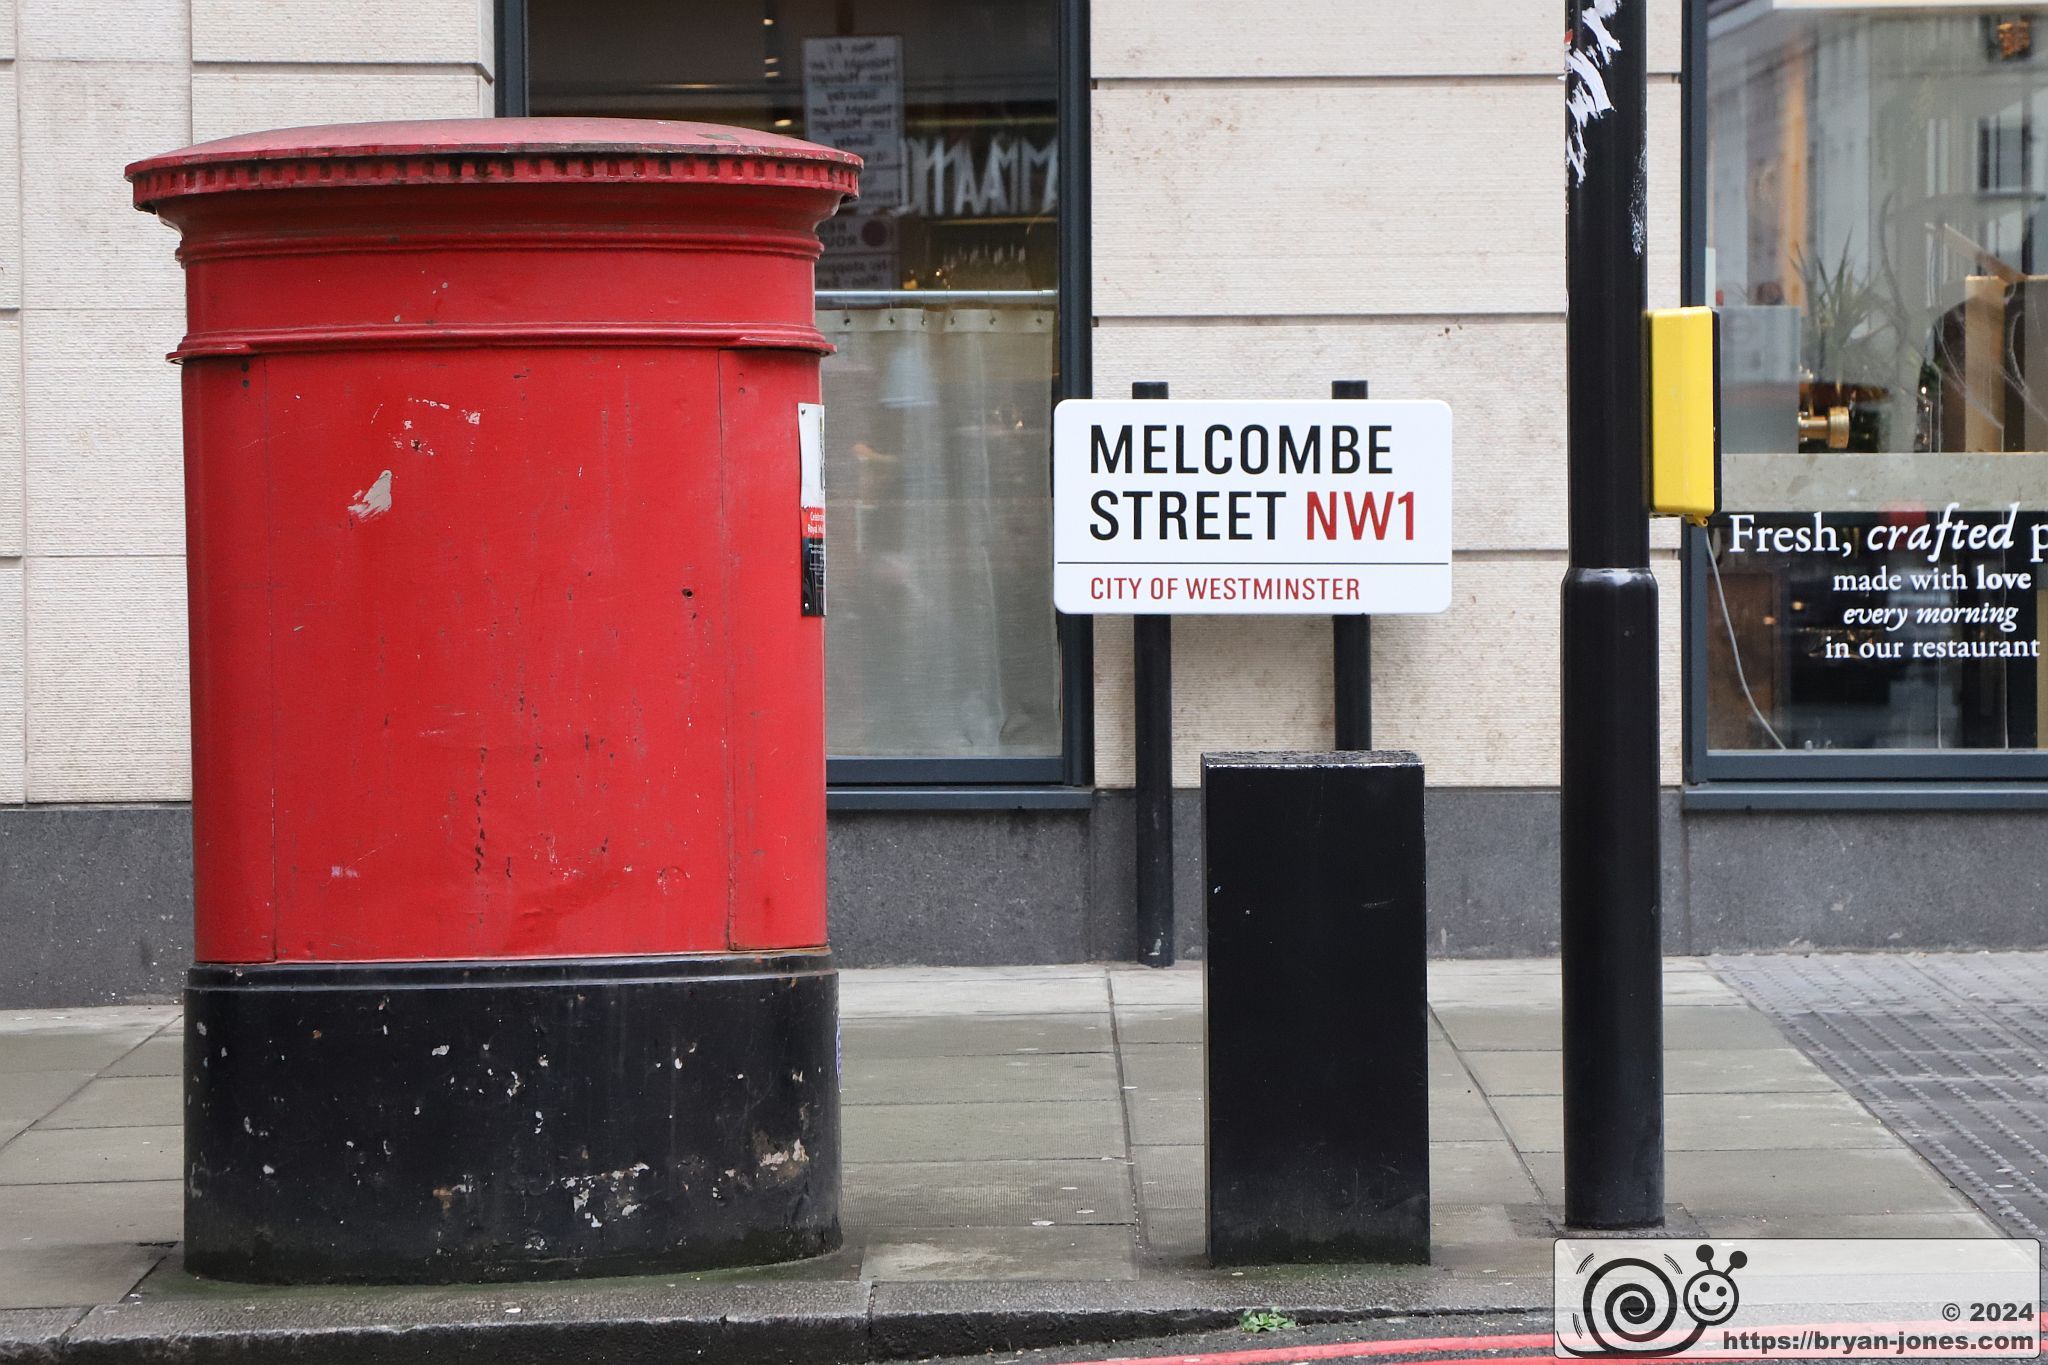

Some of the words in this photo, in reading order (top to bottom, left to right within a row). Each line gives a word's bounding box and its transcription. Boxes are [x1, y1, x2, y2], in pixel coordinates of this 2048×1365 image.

[1090, 423, 1393, 474] MELCOMBE
[1089, 490, 1287, 541] STREET
[1306, 491, 1414, 541] NW1
[1728, 511, 1853, 557] Fresh,
[1866, 501, 2021, 563] crafted
[1091, 577, 1142, 600] CITY
[1150, 577, 1179, 600] OF
[1186, 577, 1360, 600] WESTMINSTER
[1832, 565, 1902, 592] made
[1910, 565, 1968, 591] with
[1976, 564, 2032, 590] love
[1843, 607, 1909, 632] every
[1915, 602, 2019, 633] morning
[1824, 636, 1852, 659] in
[1859, 642, 1904, 659] our
[1912, 638, 2041, 659] restaurant
